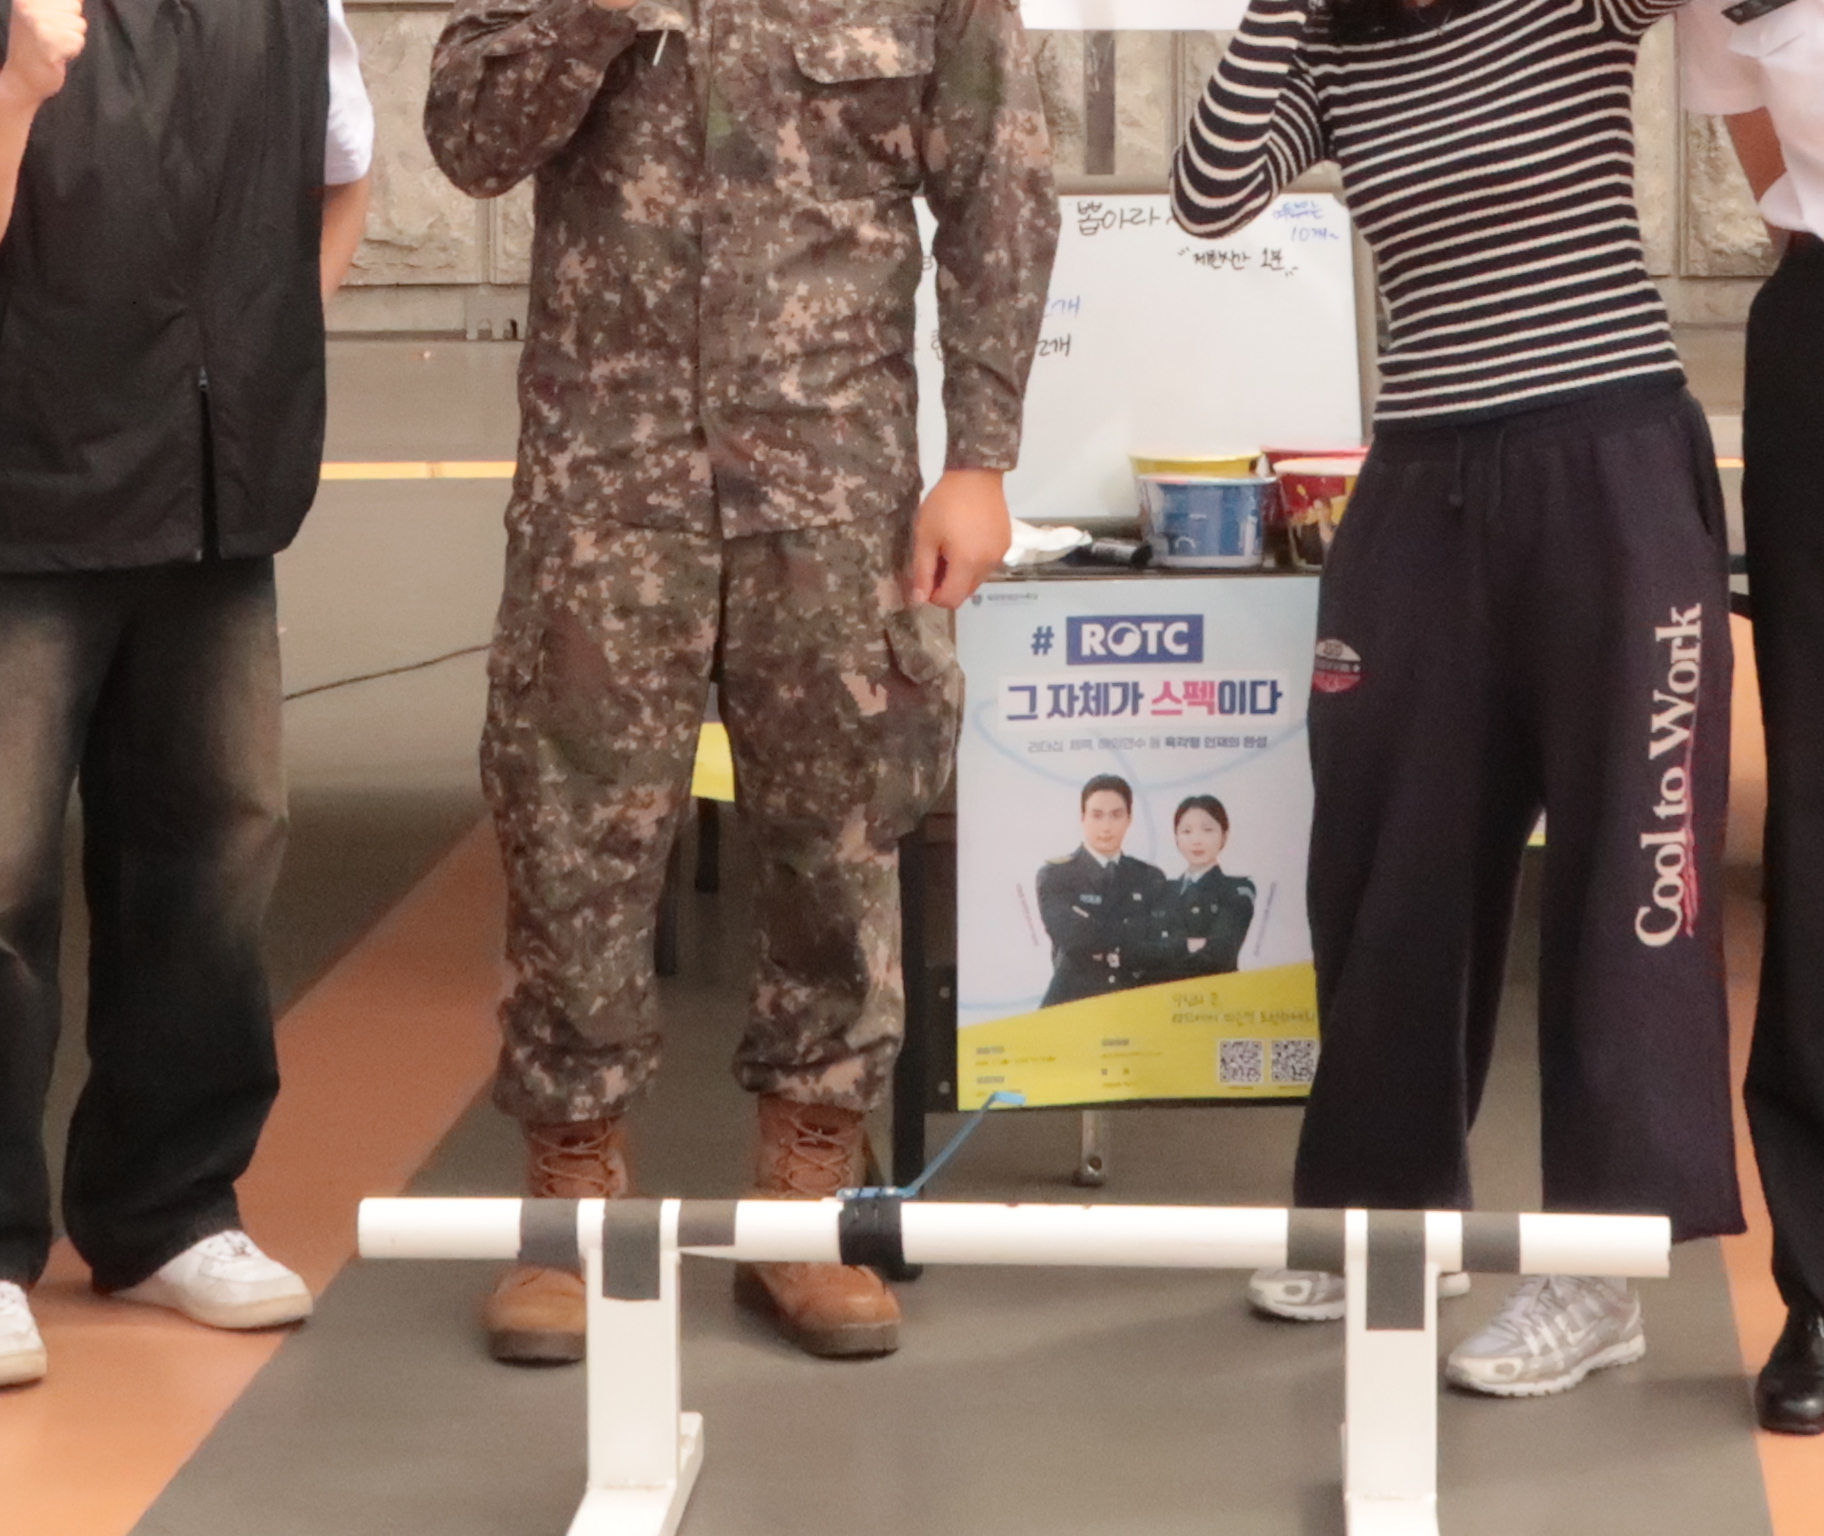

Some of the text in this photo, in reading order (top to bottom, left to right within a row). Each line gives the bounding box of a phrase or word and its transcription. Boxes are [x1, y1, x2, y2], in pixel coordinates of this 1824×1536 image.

[1076, 200, 1161, 237] 뽑아라
[1080, 620, 1190, 657] ROTC
[1006, 679, 1283, 721] 그 자체가 스펙이다
[1635, 602, 1703, 948] Cool to Work
